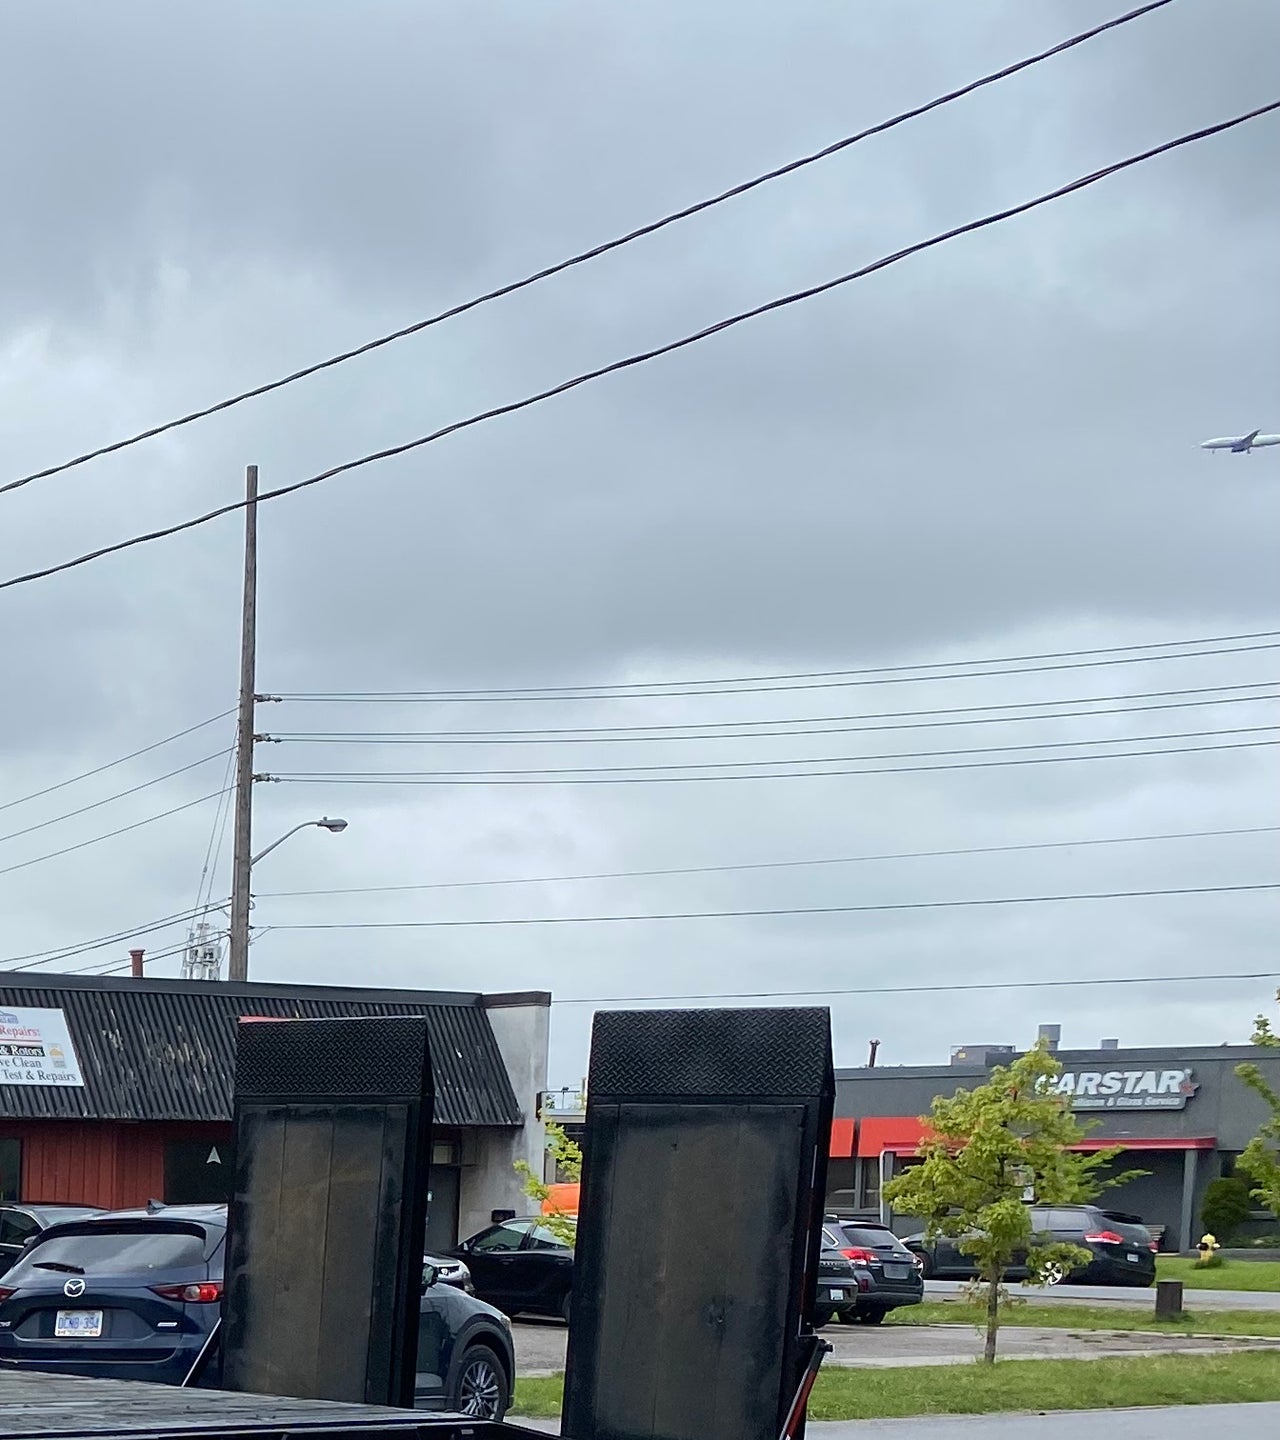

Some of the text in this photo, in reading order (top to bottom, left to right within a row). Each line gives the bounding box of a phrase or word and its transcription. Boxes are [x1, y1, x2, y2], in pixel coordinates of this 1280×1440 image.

[0, 1046, 9, 1055] &
[11, 1046, 43, 1056] Rotors
[12, 1058, 42, 1068] Clean
[2, 1070, 22, 1080] Test
[26, 1071, 35, 1080] &
[38, 1070, 76, 1082] Repairs
[1034, 1070, 1185, 1095] CARSTAR
